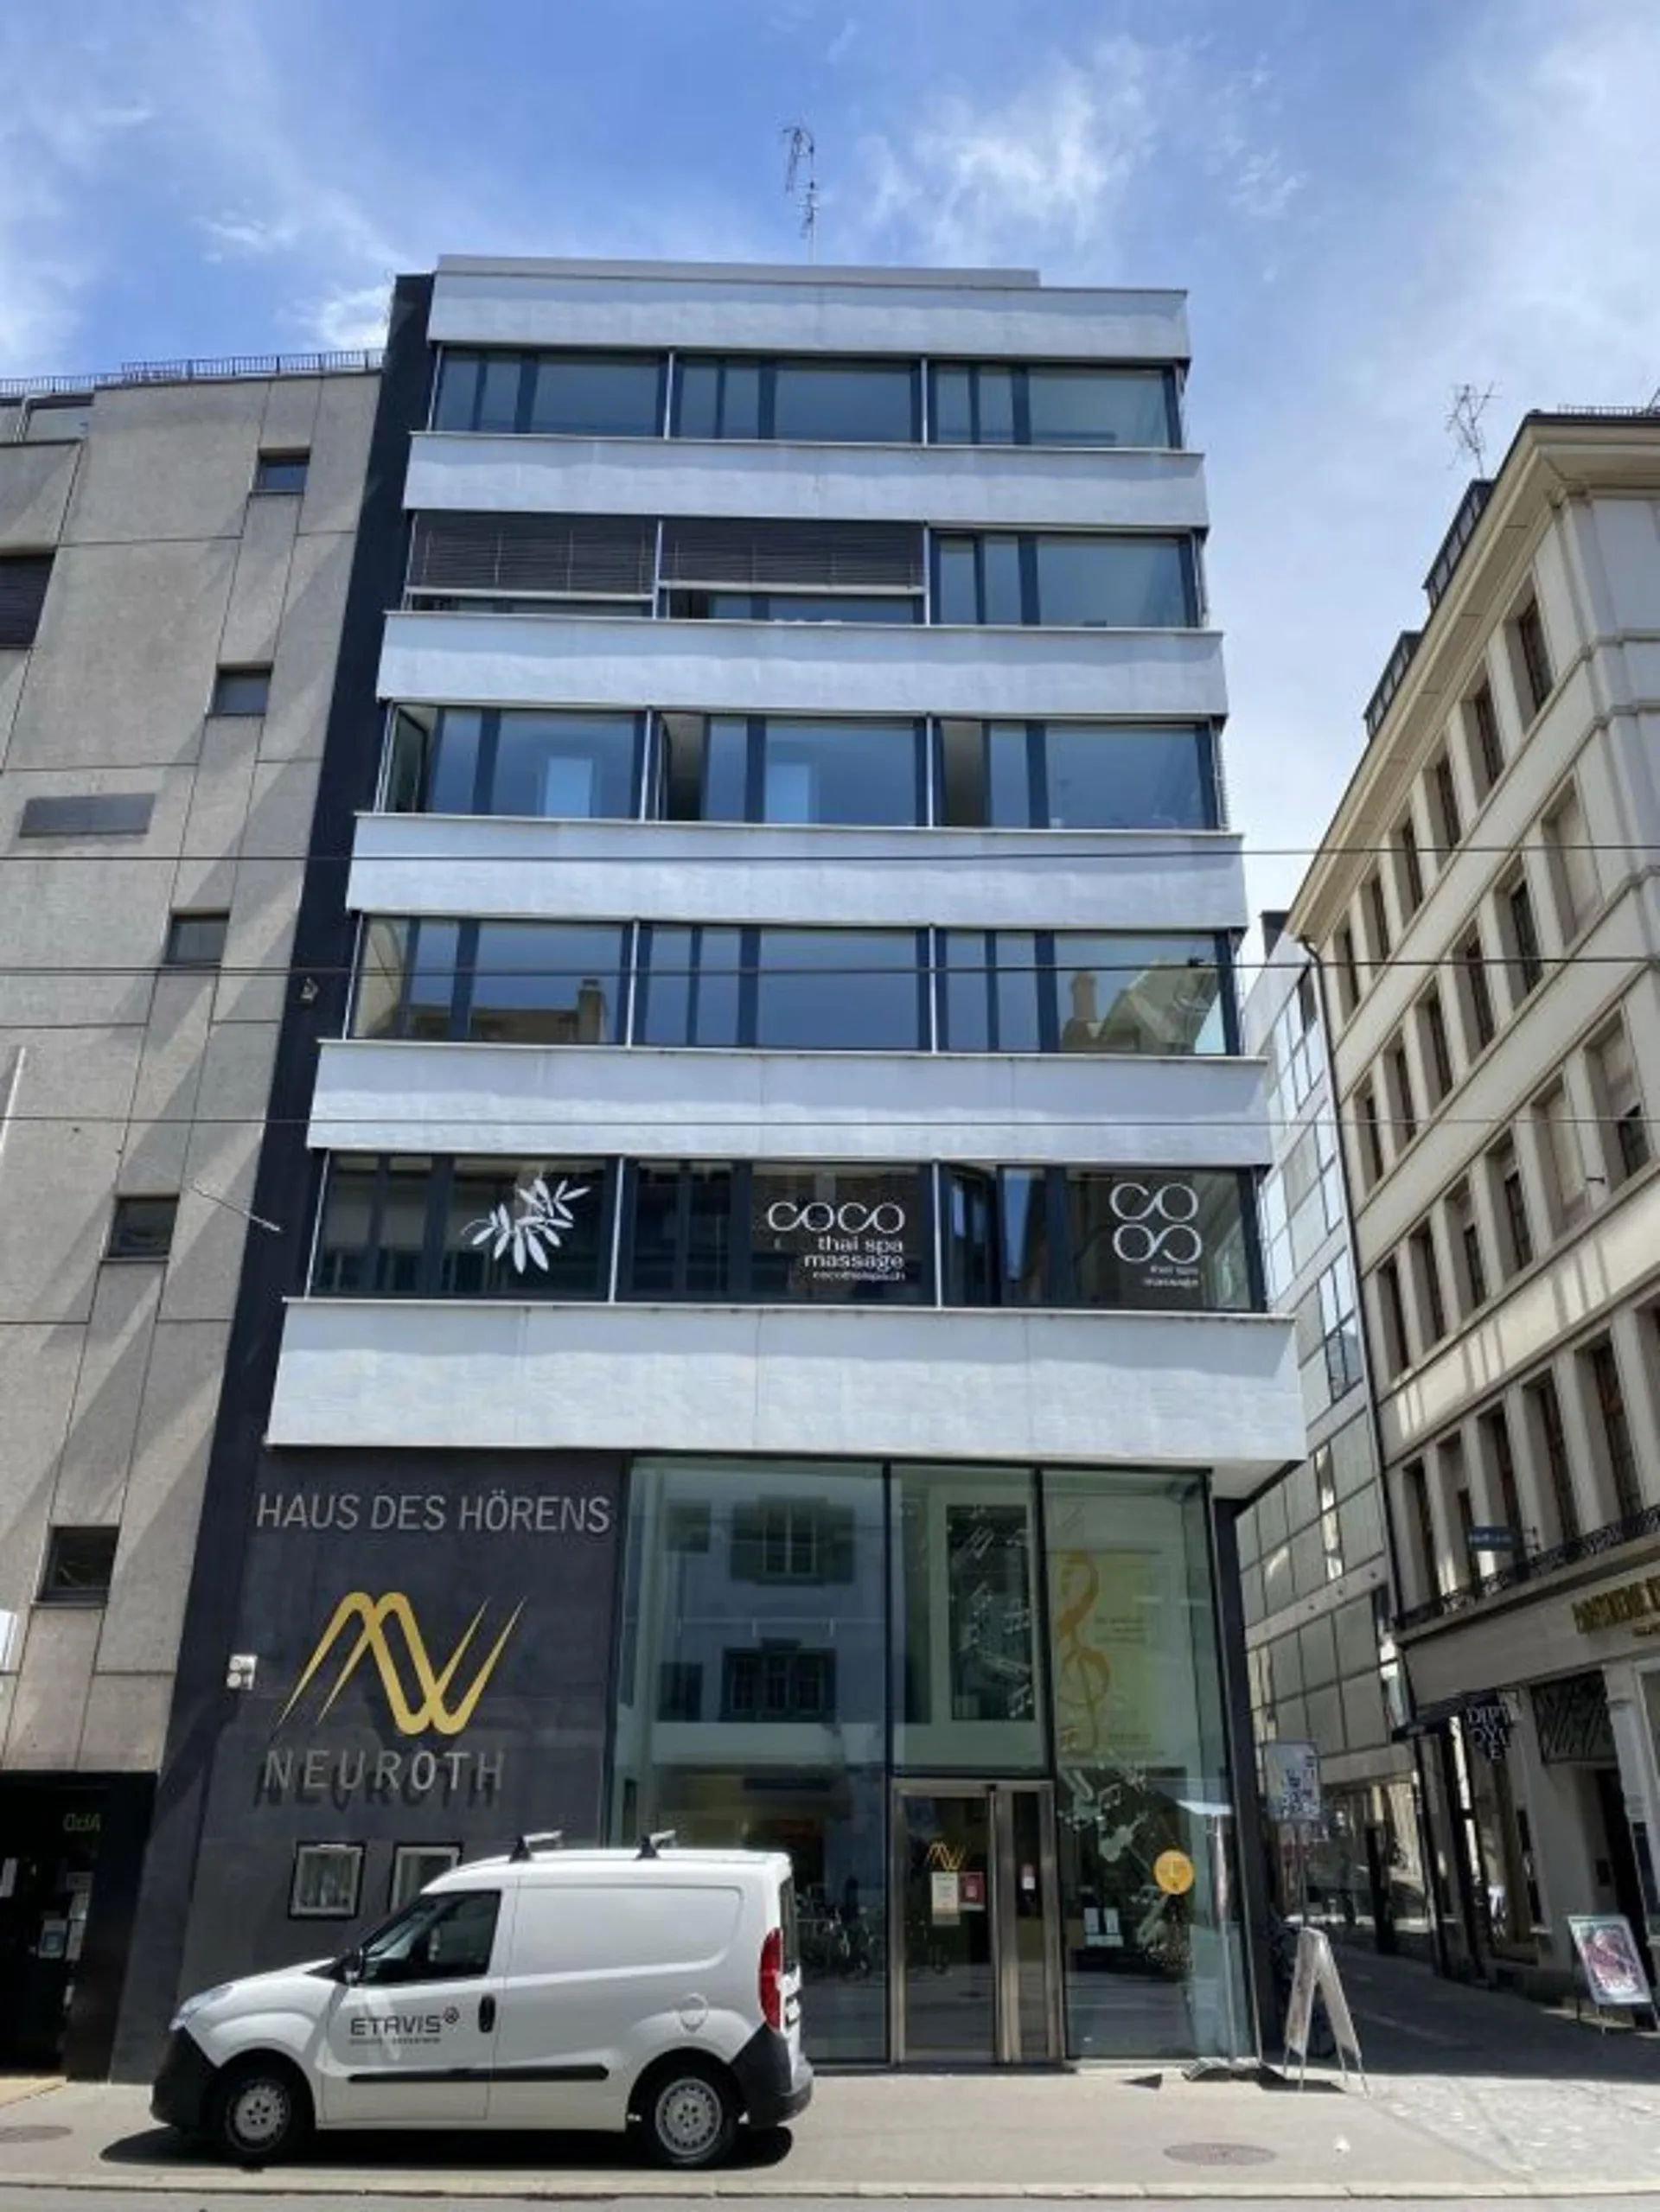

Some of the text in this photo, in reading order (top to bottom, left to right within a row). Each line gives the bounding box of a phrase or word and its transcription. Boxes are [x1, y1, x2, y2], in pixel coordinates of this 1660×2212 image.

[818, 1235, 903, 1255] thai spa
[803, 1254, 904, 1272] massage
[257, 1488, 611, 1534] HAUS DES HÖRENS
[264, 1749, 505, 1791] NEUROTH
[350, 2015, 441, 2036] ETAVIS
